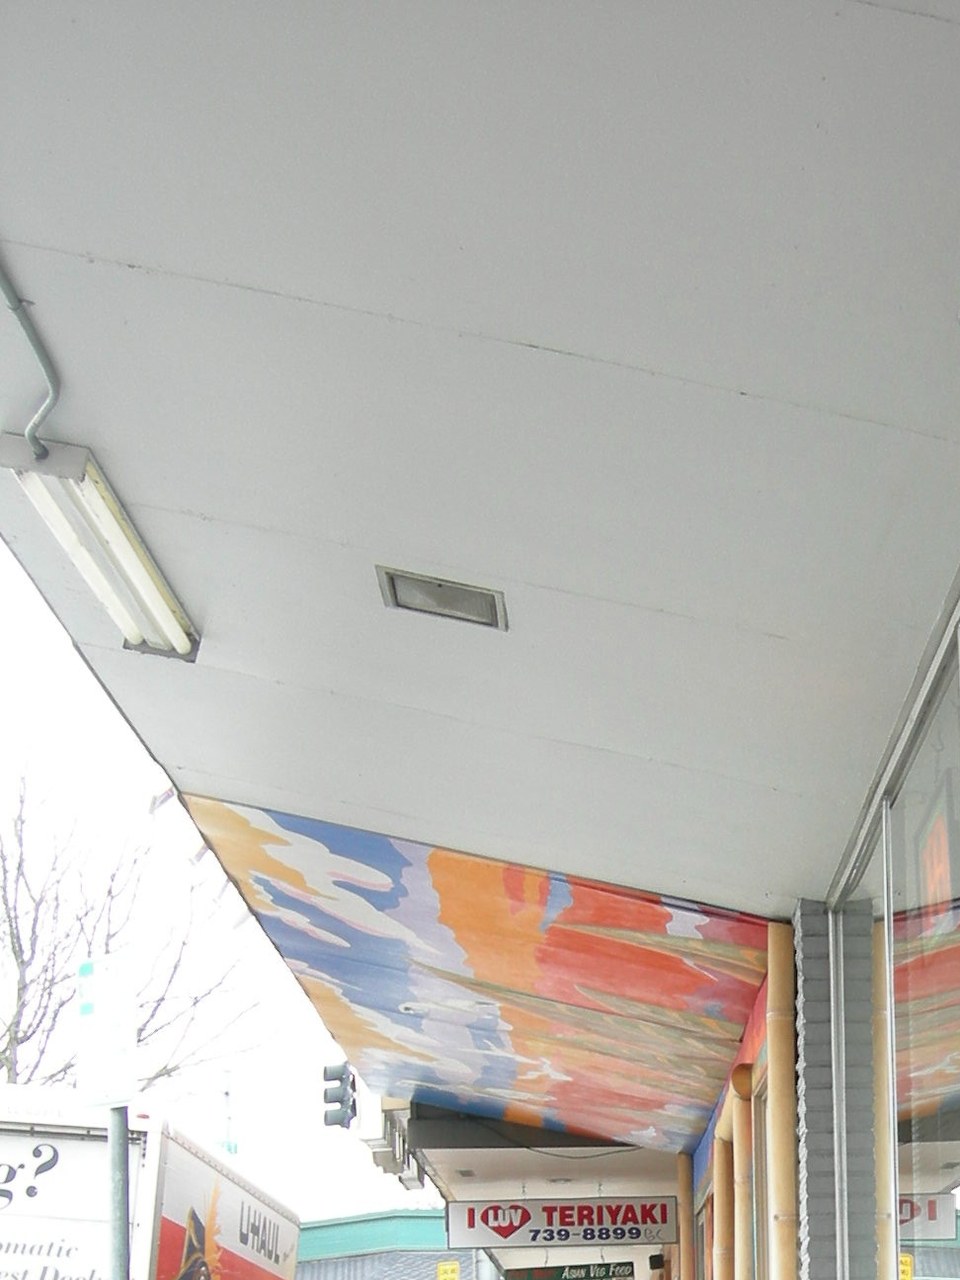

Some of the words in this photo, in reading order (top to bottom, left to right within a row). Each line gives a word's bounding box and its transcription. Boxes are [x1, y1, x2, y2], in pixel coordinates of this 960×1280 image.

[467, 1207, 475, 1229] I
[488, 1207, 523, 1228] LUV
[542, 1203, 668, 1228] TERIYAKI
[529, 1227, 643, 1242] 739-8899
[0, 1238, 79, 1258] matic
